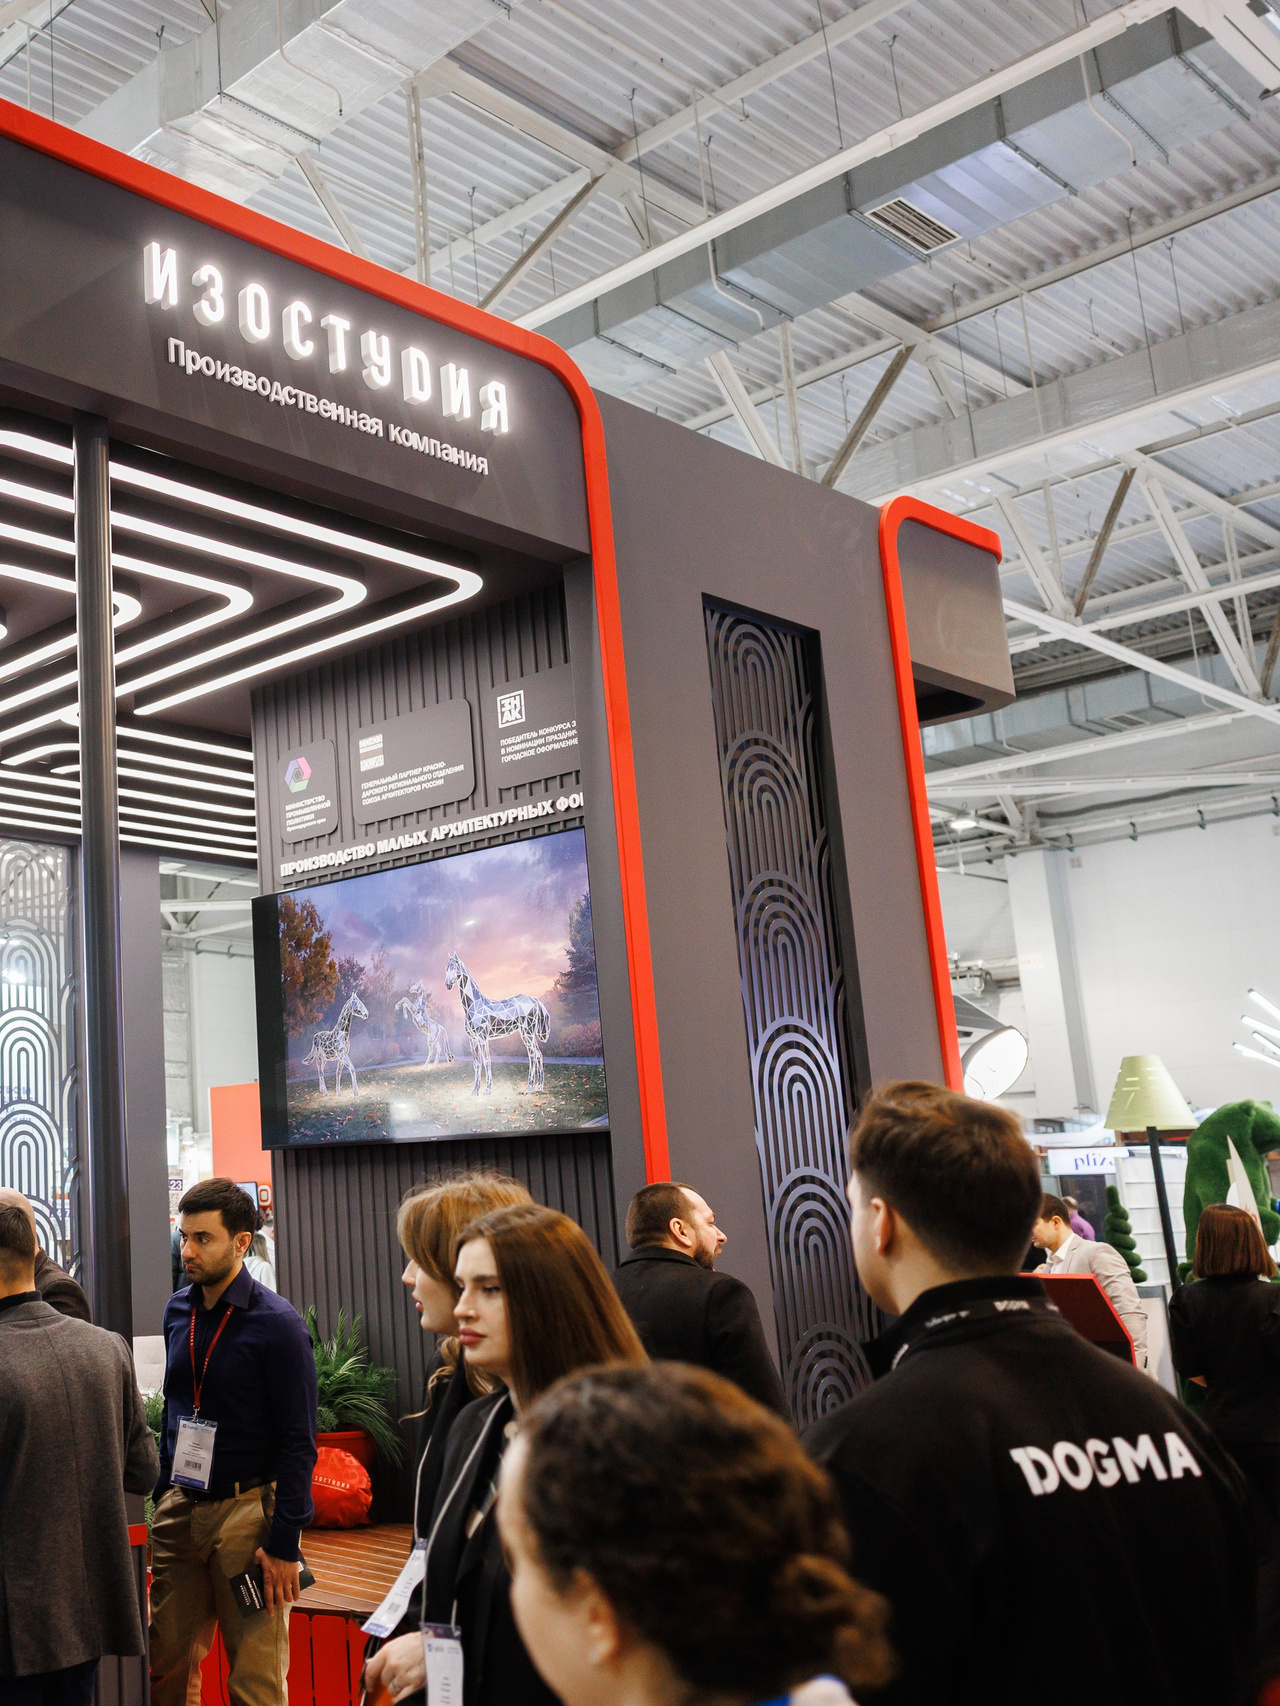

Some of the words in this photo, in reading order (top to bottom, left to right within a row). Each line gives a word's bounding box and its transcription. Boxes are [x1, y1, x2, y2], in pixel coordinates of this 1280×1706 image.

[167, 336, 384, 438] Производственная
[388, 422, 489, 476] компания
[500, 730, 538, 747] ПОБЕДИТЕЛЬ
[539, 721, 571, 736] КОНКУРСА
[500, 747, 506, 755] В
[506, 737, 545, 754] НОМИНАЦИИ
[501, 748, 536, 764] ГОРОДСКОЕ
[536, 737, 579, 755] ОФОРМЛЕНИЕ
[361, 772, 399, 790] ГЕНЕРАЛЬНЫЙ
[398, 767, 423, 780] ПАРТНЕР
[422, 761, 447, 772] КРАСНО-
[361, 786, 388, 799] ДАРСКОГО
[388, 773, 432, 791] РЕГИОНАЛЬНОГО
[432, 764, 465, 778] ОТДЕЛЕНИЯ
[362, 796, 381, 806] СОЮЗА
[381, 784, 422, 801] АРХИТЕКТОРОВ
[421, 778, 445, 790] РОССИИ
[280, 843, 376, 878] ПРОИЗВОДСТВО
[377, 829, 429, 855] МАЛЫХ
[430, 799, 555, 843] АРХИТЕКТУРНЫХ
[1008, 1431, 1203, 1497] DOGMA
